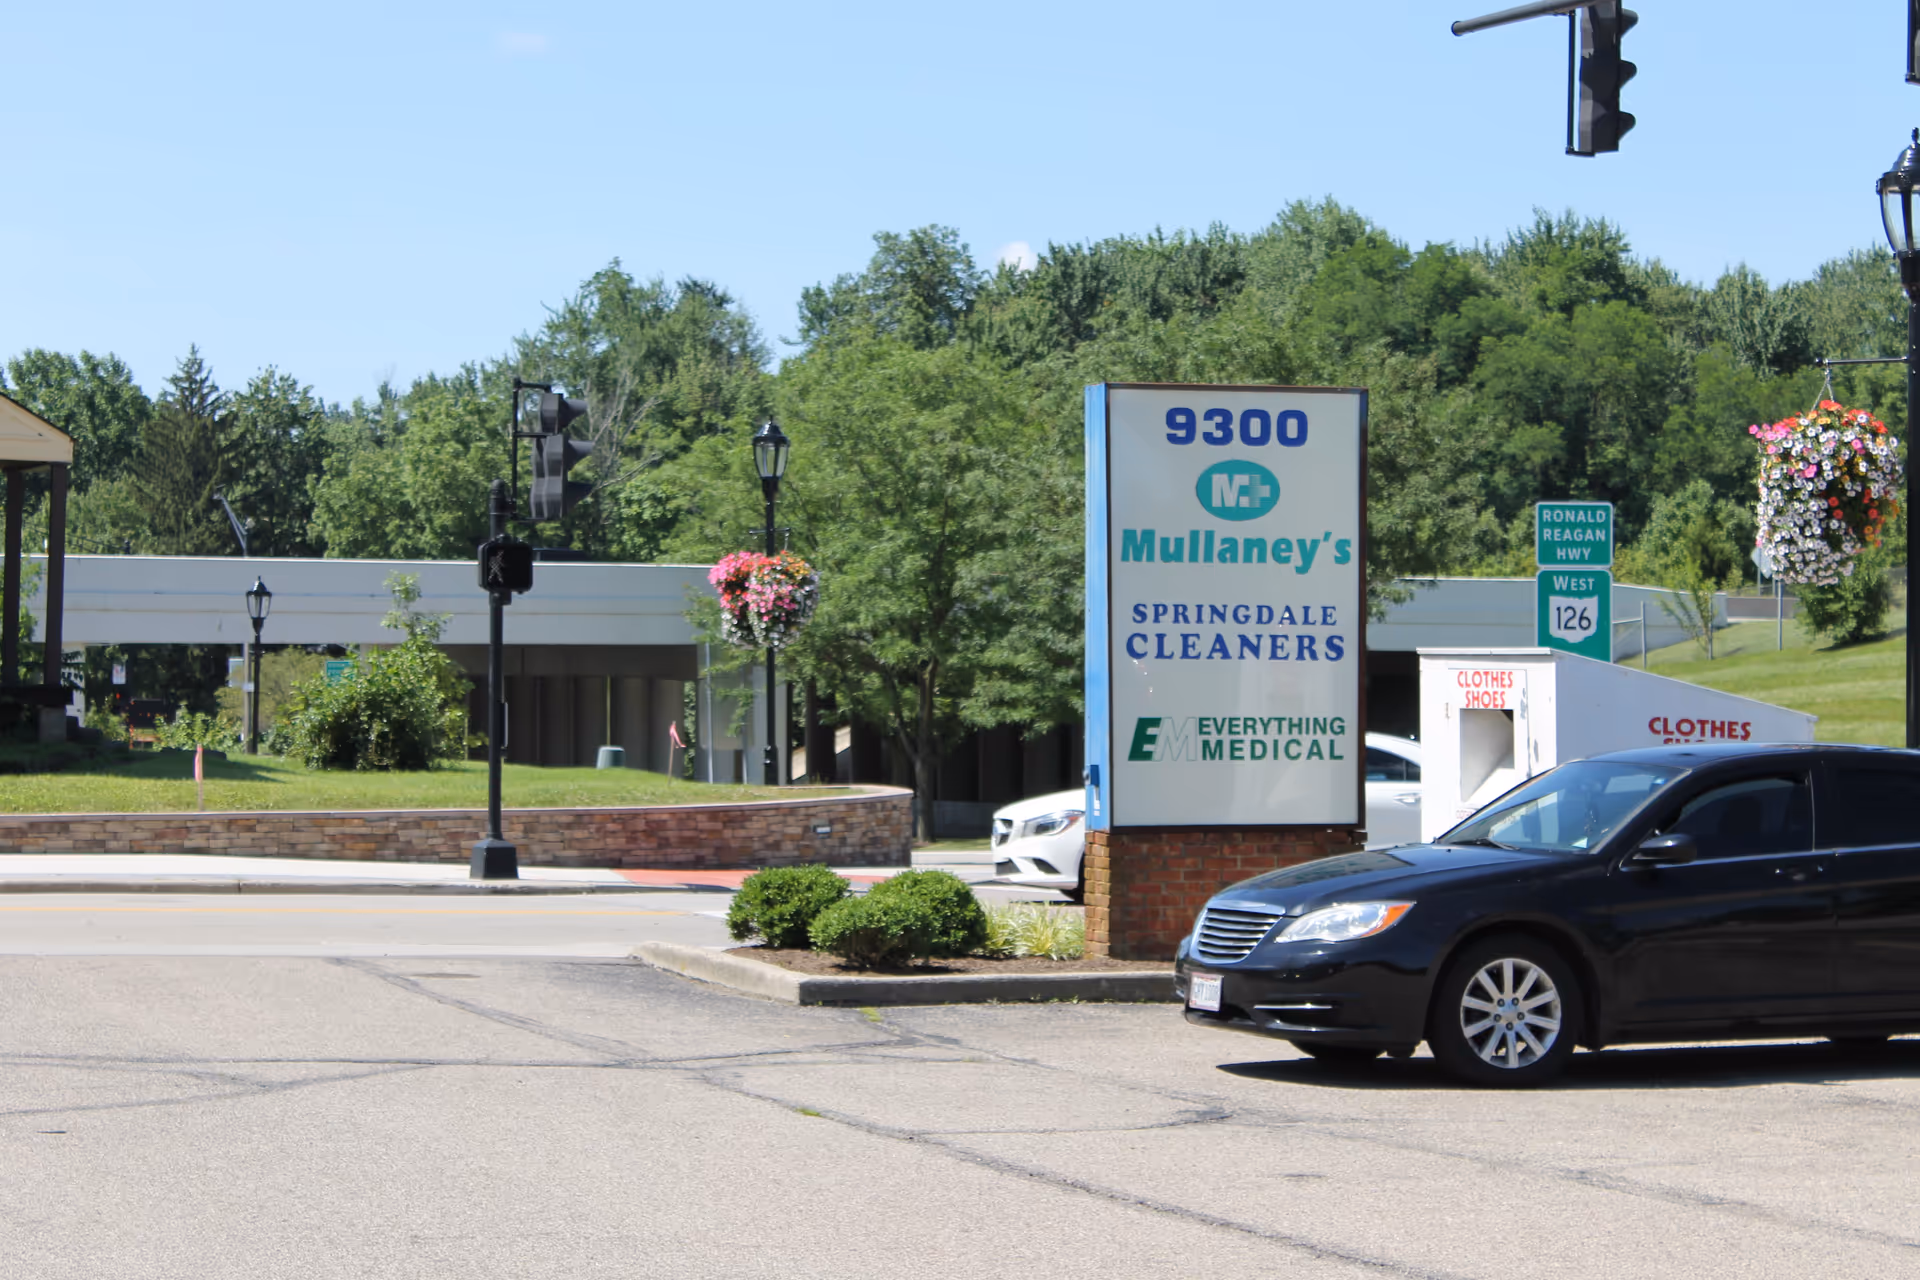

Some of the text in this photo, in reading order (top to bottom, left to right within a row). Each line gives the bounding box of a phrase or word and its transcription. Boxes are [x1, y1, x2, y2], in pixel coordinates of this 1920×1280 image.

[1165, 406, 1309, 448] 9300
[1542, 508, 1607, 523] RONALD
[1542, 528, 1607, 542] REAGAN
[1120, 528, 1353, 575] Mullaney's
[1556, 547, 1592, 561] HWY
[1552, 575, 1596, 591] WEST
[1131, 602, 1338, 626] SPRINGDALE
[1556, 605, 1593, 631] 126
[1125, 632, 1346, 662] CLEANERS
[1456, 670, 1514, 689] CLOTHES
[1464, 689, 1507, 709] SHOES
[1198, 716, 1346, 736] EVERYTHING
[1647, 716, 1752, 741] CLOTHES
[1201, 738, 1345, 761] MEDICAL
